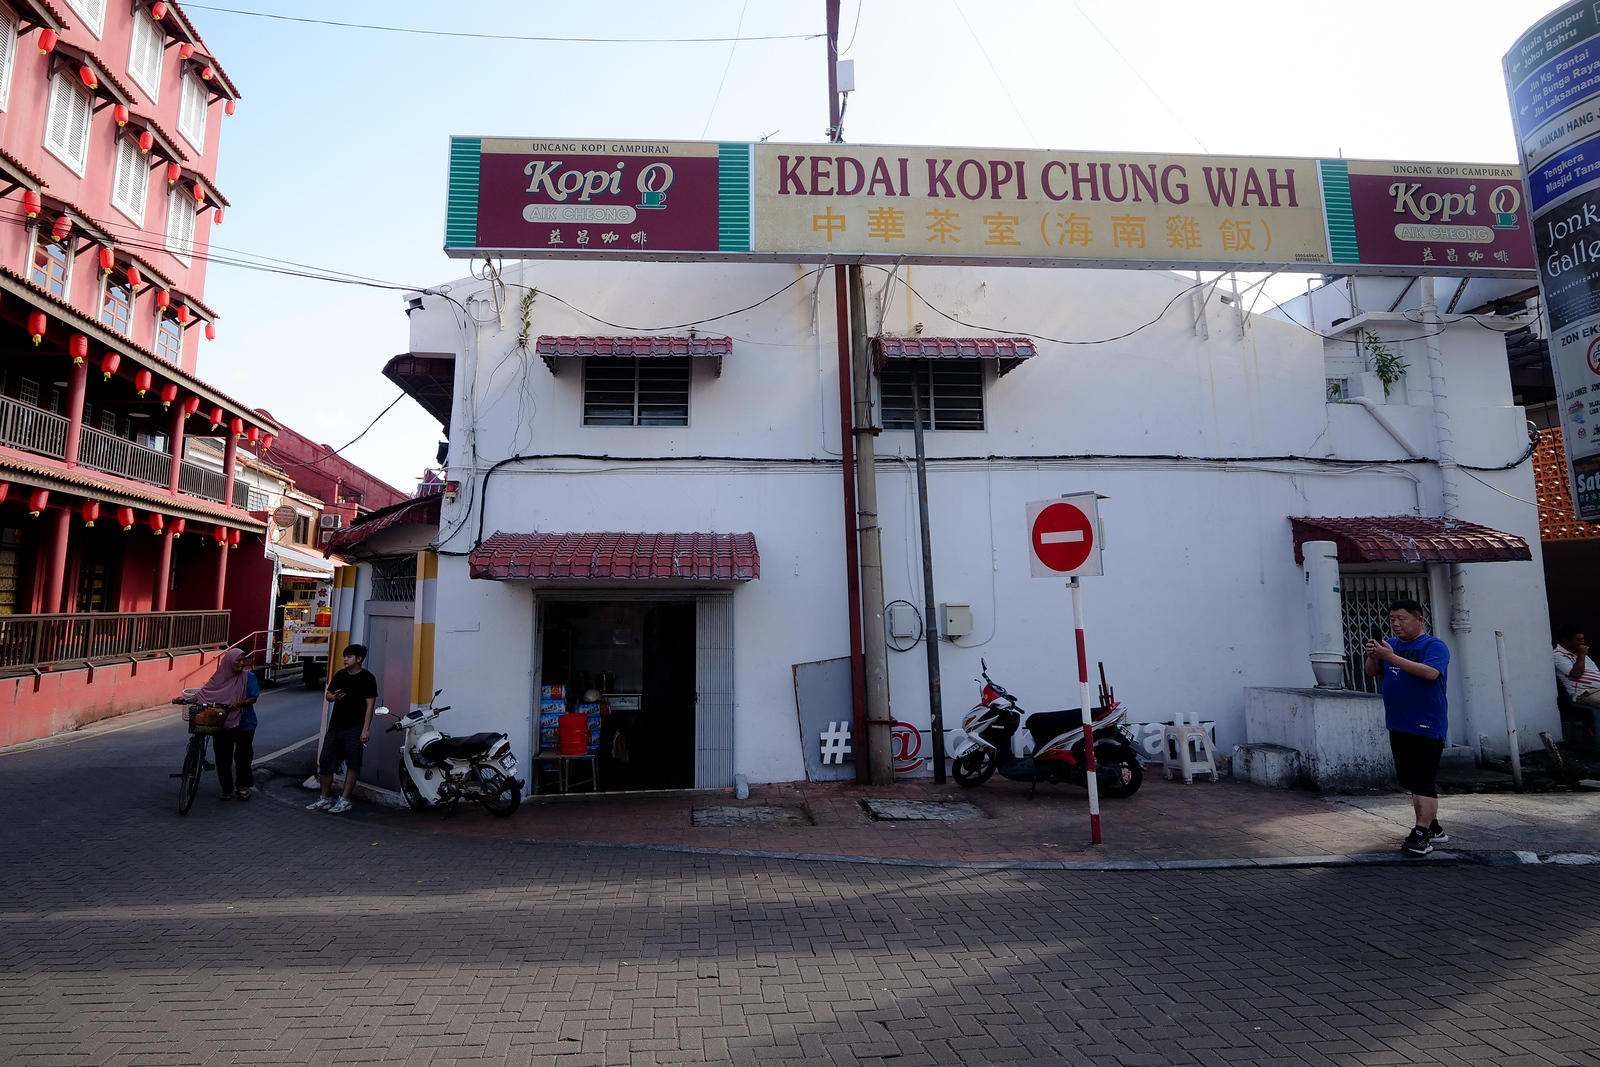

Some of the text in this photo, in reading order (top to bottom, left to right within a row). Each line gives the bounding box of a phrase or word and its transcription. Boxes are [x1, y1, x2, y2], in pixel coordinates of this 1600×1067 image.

[1521, 9, 1585, 57] Kuala Lumpur
[1524, 28, 1577, 68] Johor Bahru
[1529, 49, 1590, 92] Jln Kg. Pantai
[1532, 60, 1600, 105] Jln Bunga Raya
[1534, 75, 1600, 118] Jln Laksamana
[1540, 126, 1566, 150] MAKAM
[1566, 112, 1594, 133] HANG
[532, 143, 669, 154] UNCANG KOPI CAMPURAN
[523, 160, 627, 203] Kopi
[777, 154, 1299, 208] KEDAI KOPI CHUNG WAH
[1393, 165, 1513, 177] UNCANG KOPI CAMPURAN
[1544, 154, 1584, 180] Tengkera
[1546, 172, 1573, 193] Masjid
[529, 206, 630, 221] AIK CHEONG
[1388, 182, 1478, 222] Kopi
[547, 229, 648, 246] 益昌咖啡
[1401, 227, 1489, 241] AIK CHEONG
[1422, 247, 1510, 264] 益昌咖啡
[1561, 331, 1580, 347] ZON
